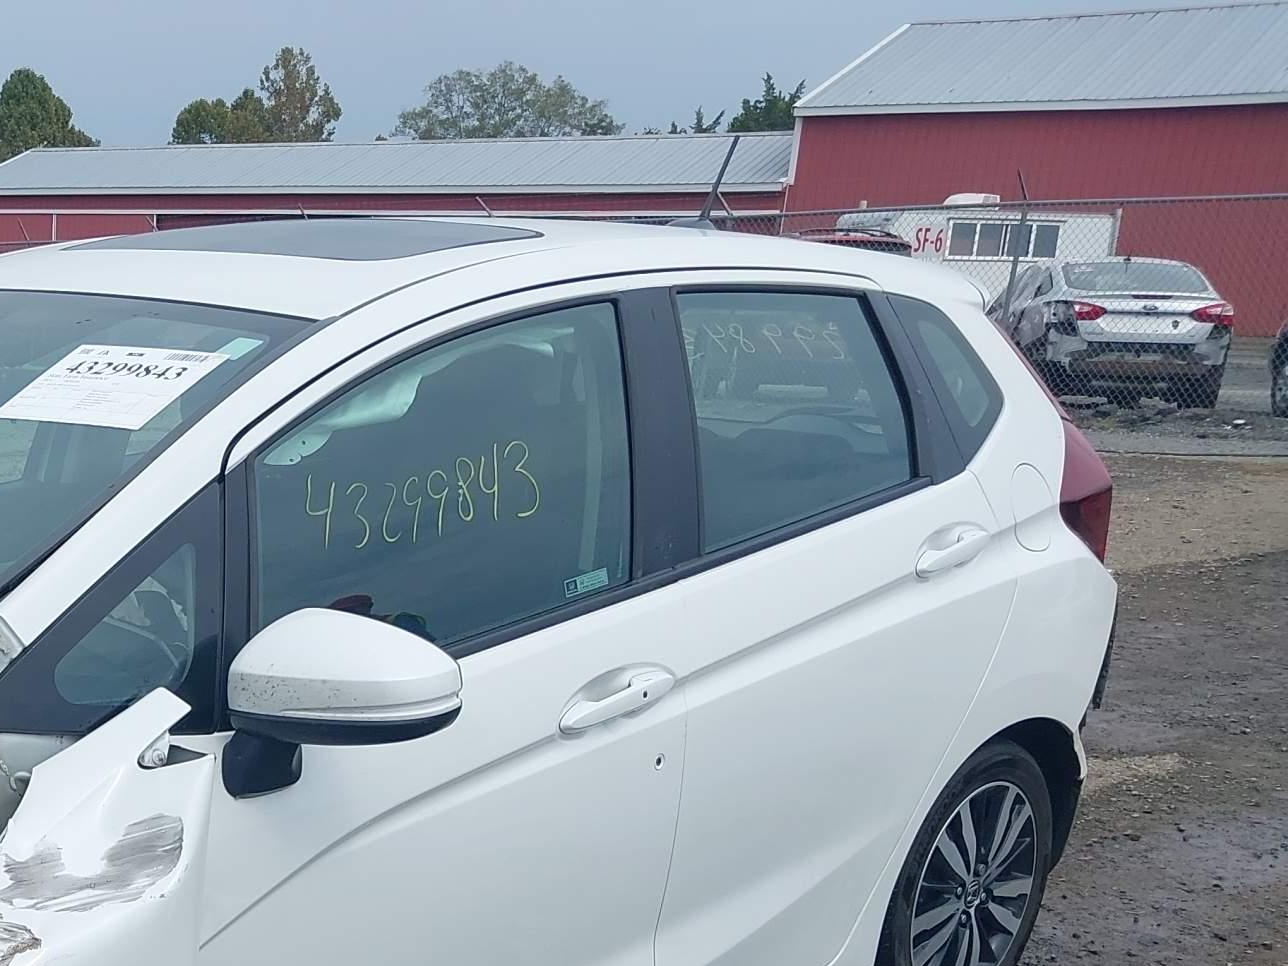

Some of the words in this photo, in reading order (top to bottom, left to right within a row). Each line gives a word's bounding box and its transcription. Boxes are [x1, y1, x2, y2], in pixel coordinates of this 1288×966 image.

[913, 227, 944, 253] SF-6
[65, 360, 189, 382] 43299843
[305, 440, 541, 552] 43299843
